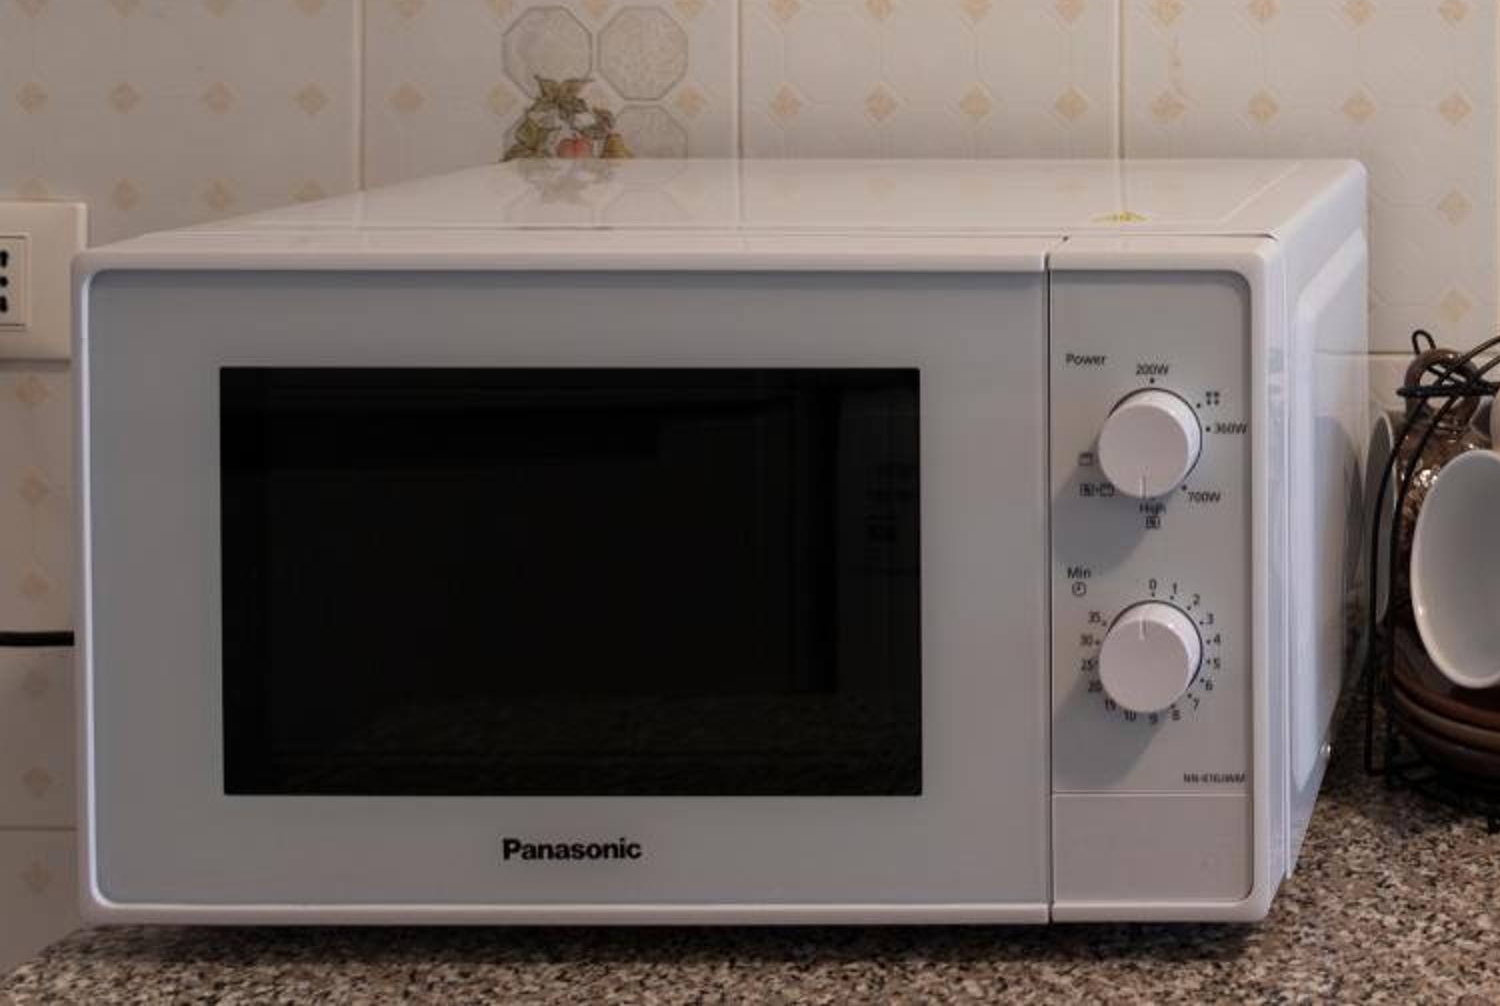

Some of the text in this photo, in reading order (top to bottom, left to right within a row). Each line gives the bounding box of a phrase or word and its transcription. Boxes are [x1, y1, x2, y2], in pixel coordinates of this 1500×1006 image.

[1066, 353, 1107, 366] Power
[1136, 364, 1169, 375] 200W
[1187, 492, 1221, 503] 700W
[1139, 503, 1166, 516] High
[1067, 567, 1091, 579] Min
[1149, 578, 1157, 591] 0
[1193, 594, 1201, 606] 2
[1205, 613, 1214, 624] 3
[1213, 634, 1221, 644] 4
[1213, 657, 1221, 670] 5
[1205, 679, 1213, 691] 6
[1192, 697, 1200, 710] 7
[502, 837, 642, 861] Panasonic
